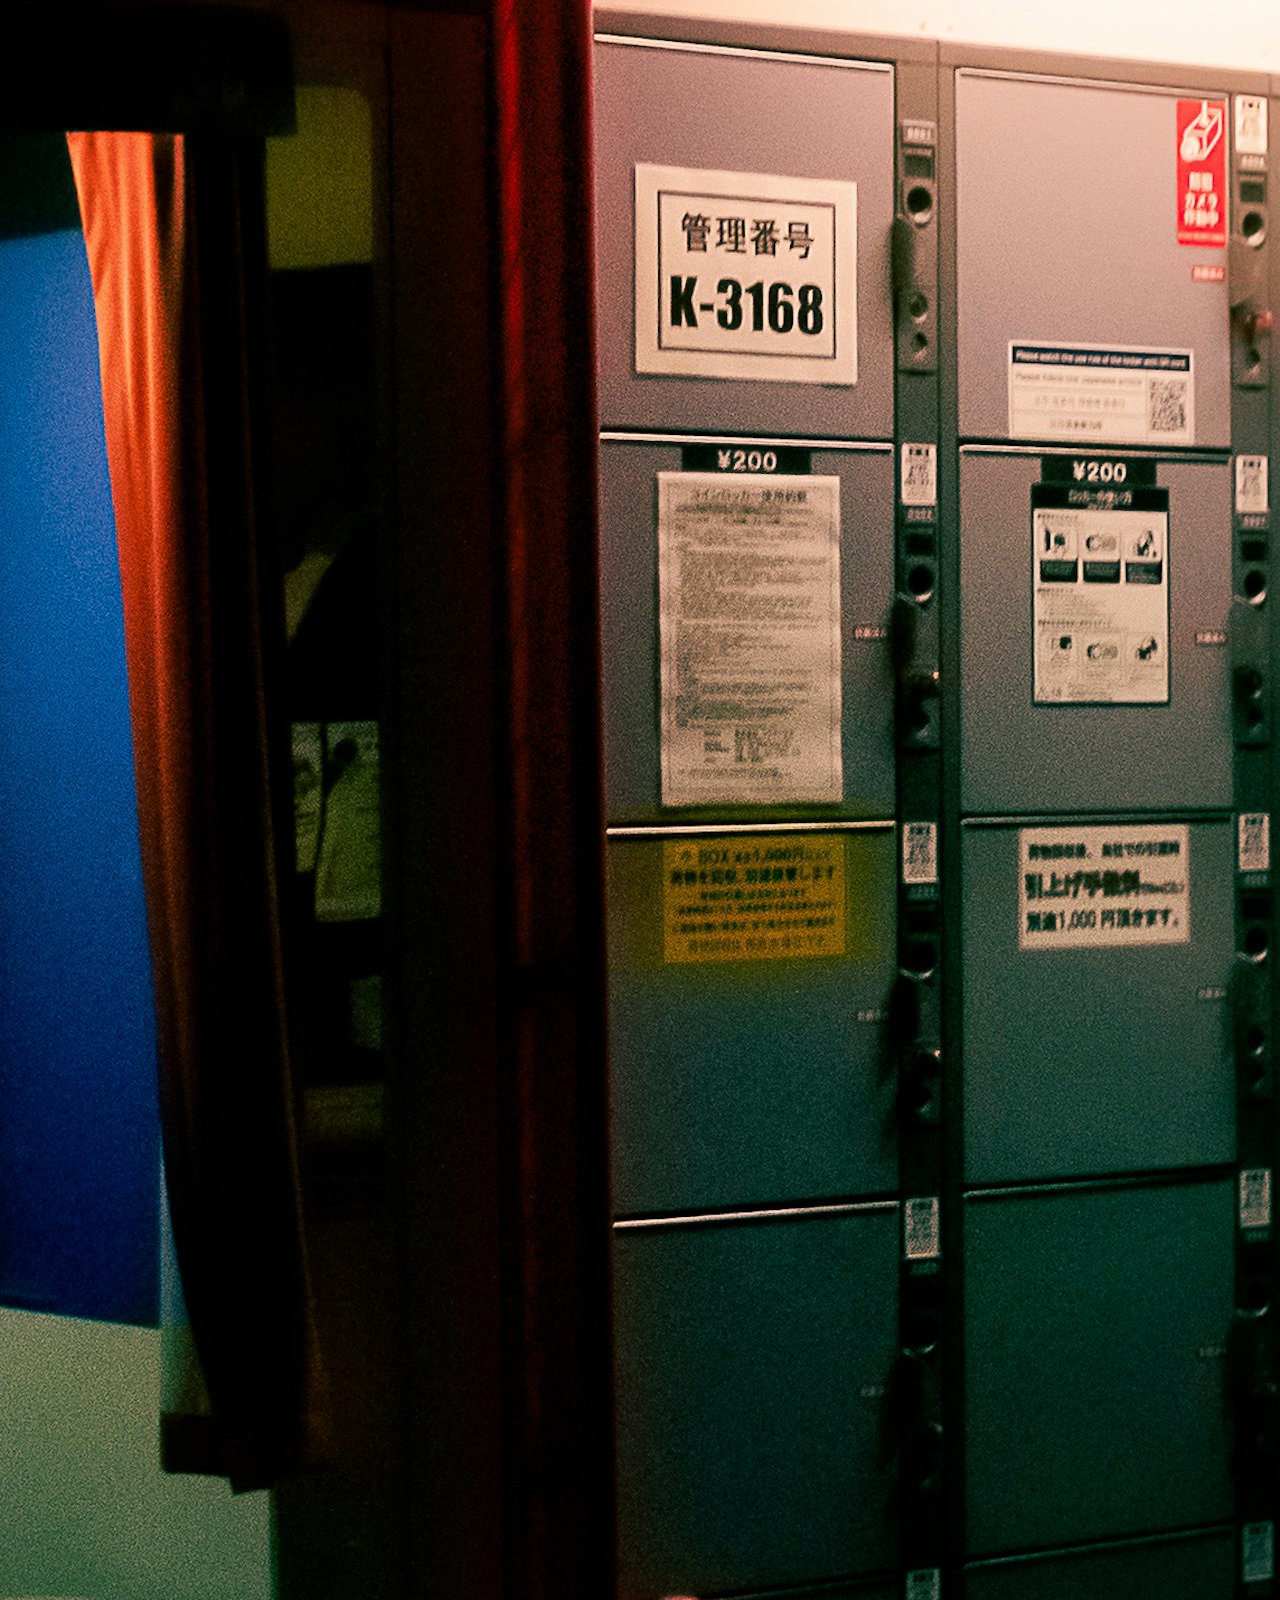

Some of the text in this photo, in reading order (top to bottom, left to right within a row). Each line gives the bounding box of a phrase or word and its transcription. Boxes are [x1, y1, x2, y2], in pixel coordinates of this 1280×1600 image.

[681, 211, 815, 260] 管理番号
[669, 274, 824, 336] K-3168
[717, 449, 778, 472] ¥200
[1072, 459, 1128, 484] ¥200
